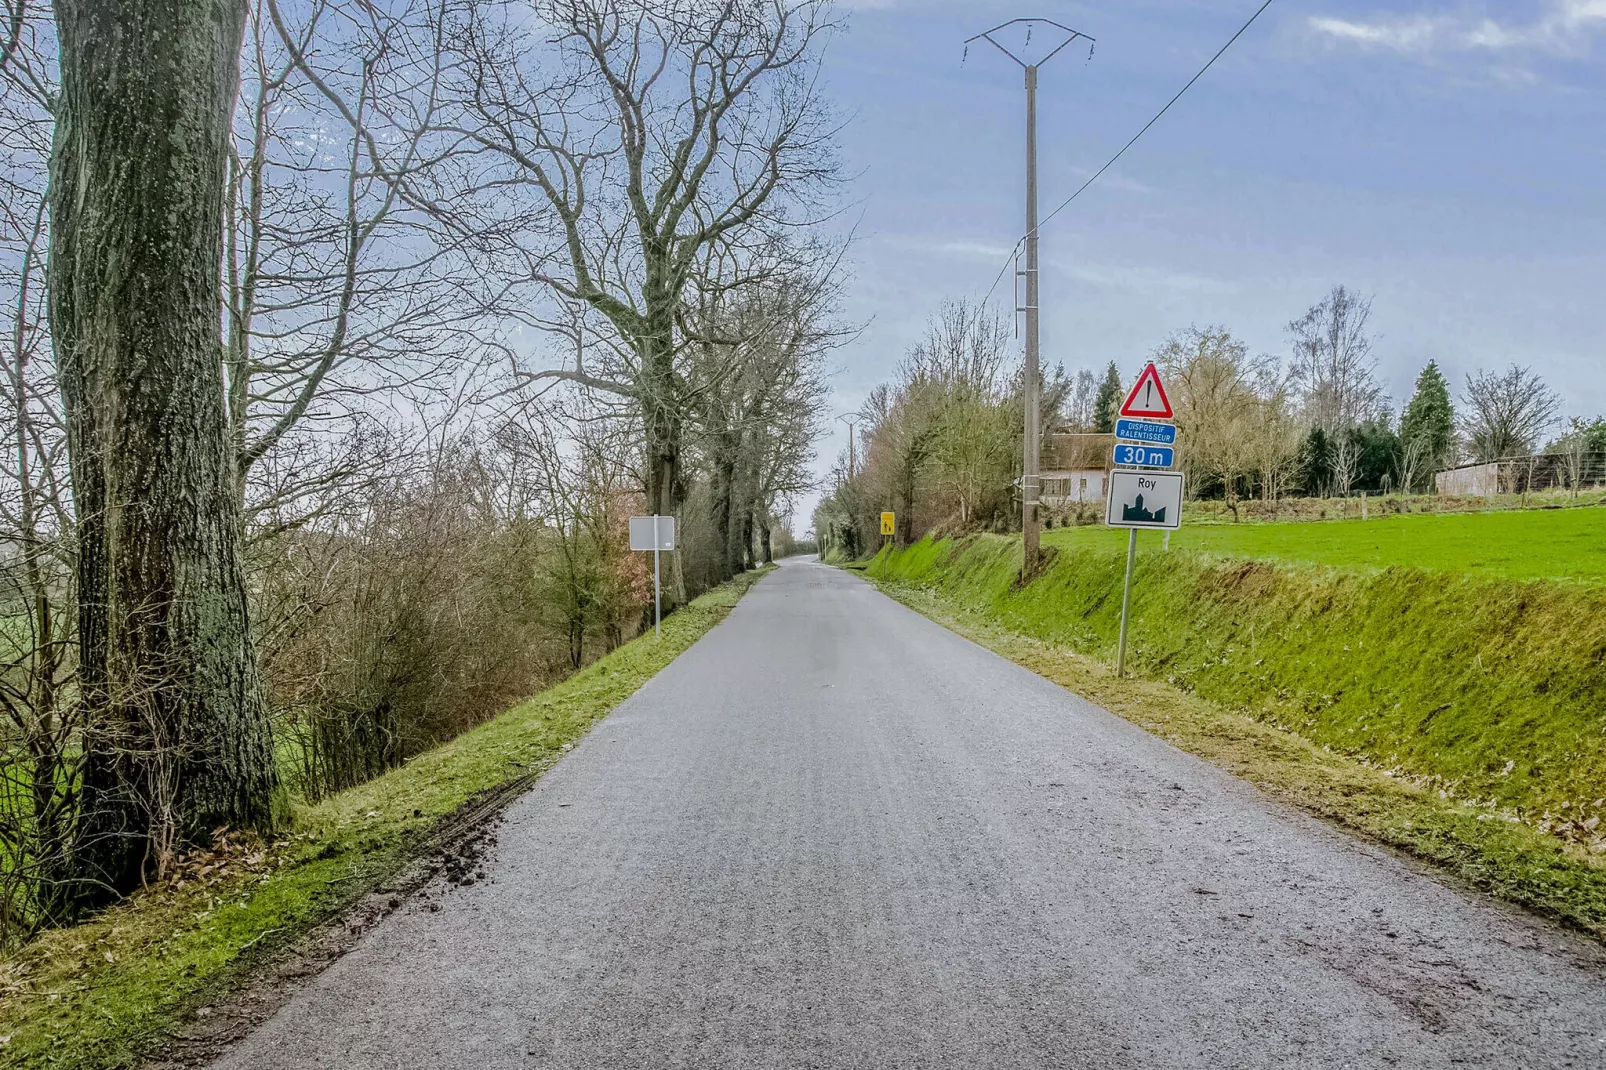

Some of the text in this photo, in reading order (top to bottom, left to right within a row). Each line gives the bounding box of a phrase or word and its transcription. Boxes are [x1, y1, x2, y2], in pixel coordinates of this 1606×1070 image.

[1128, 422, 1166, 433] DISPOSITIF
[1120, 430, 1171, 442] RALENTISSEUR
[1124, 447, 1163, 465] 30 m
[1138, 477, 1156, 491] Roy
